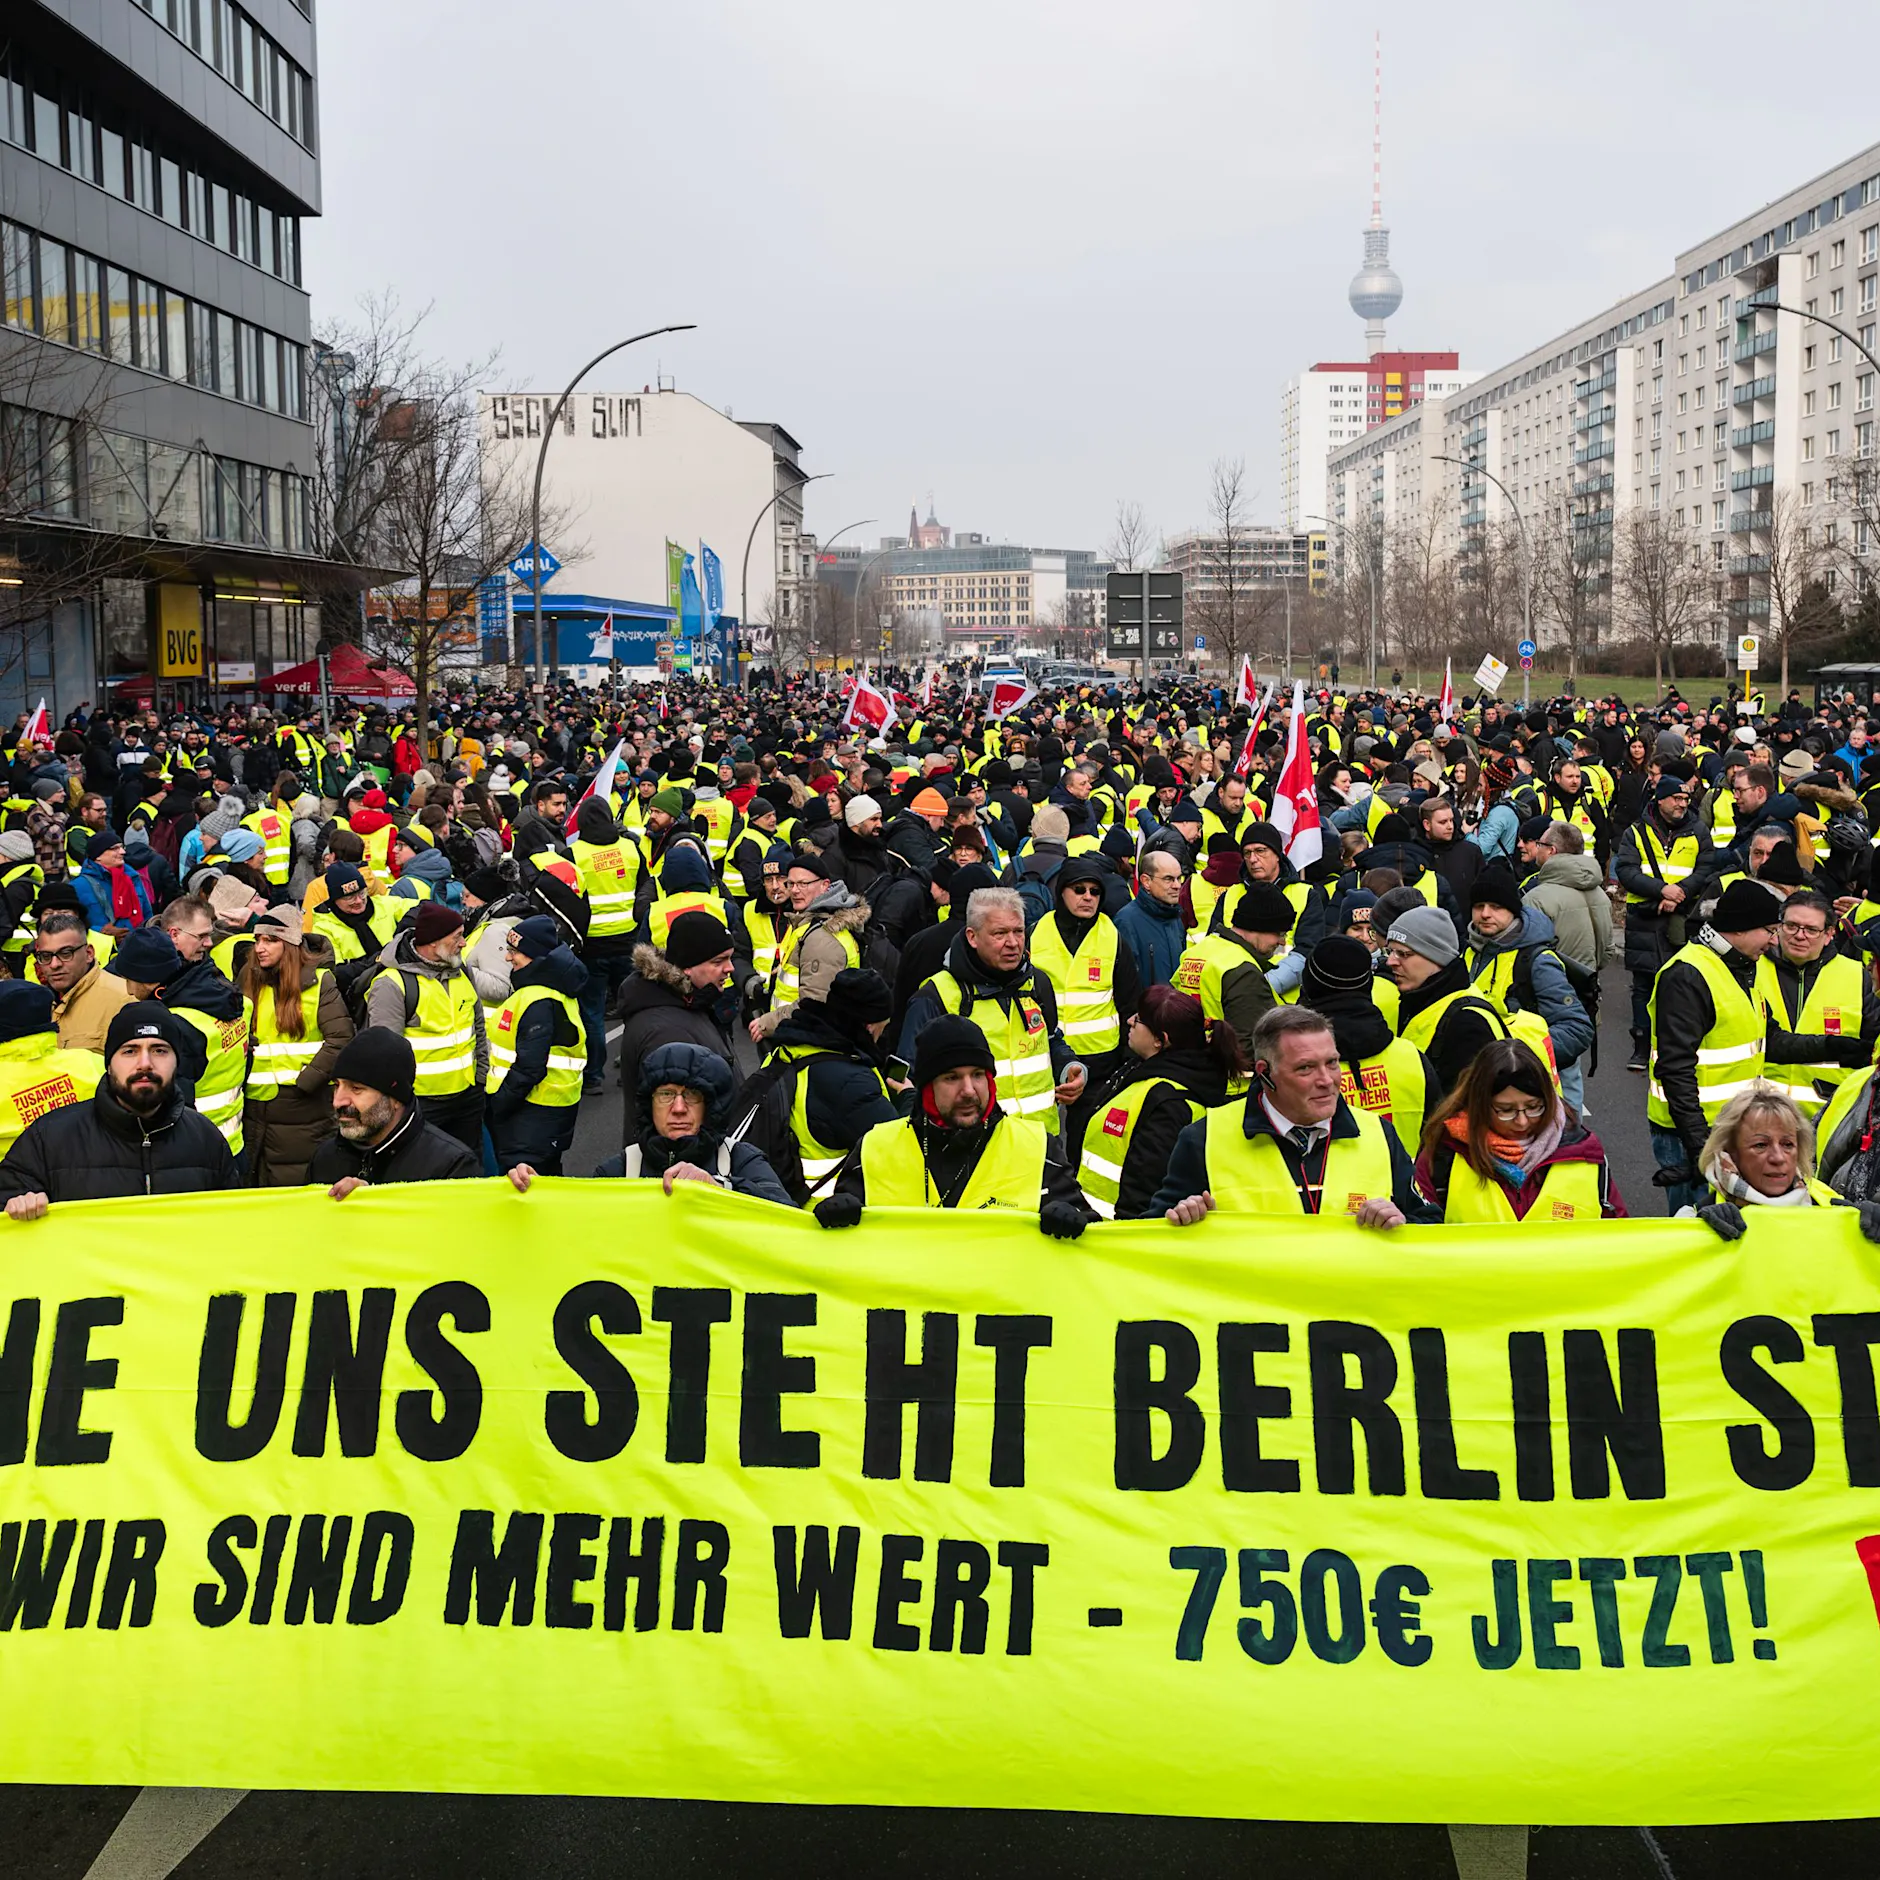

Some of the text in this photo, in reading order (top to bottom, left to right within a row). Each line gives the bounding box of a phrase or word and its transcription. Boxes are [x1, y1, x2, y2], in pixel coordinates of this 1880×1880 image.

[167, 630, 197, 665] BVG
[593, 850, 622, 863] ZUSAMMEN
[609, 857, 624, 867] MEHR
[13, 1077, 74, 1112] ZUSAMMEN
[48, 1092, 78, 1112] MEHR
[1359, 1088, 1391, 1107] MEHR
[195, 1281, 491, 1463] UNS
[1114, 1320, 1666, 1502] BERLIN
[0, 1510, 1777, 1670] WIR SIND MEHR WERT - 750€ JETZT!
